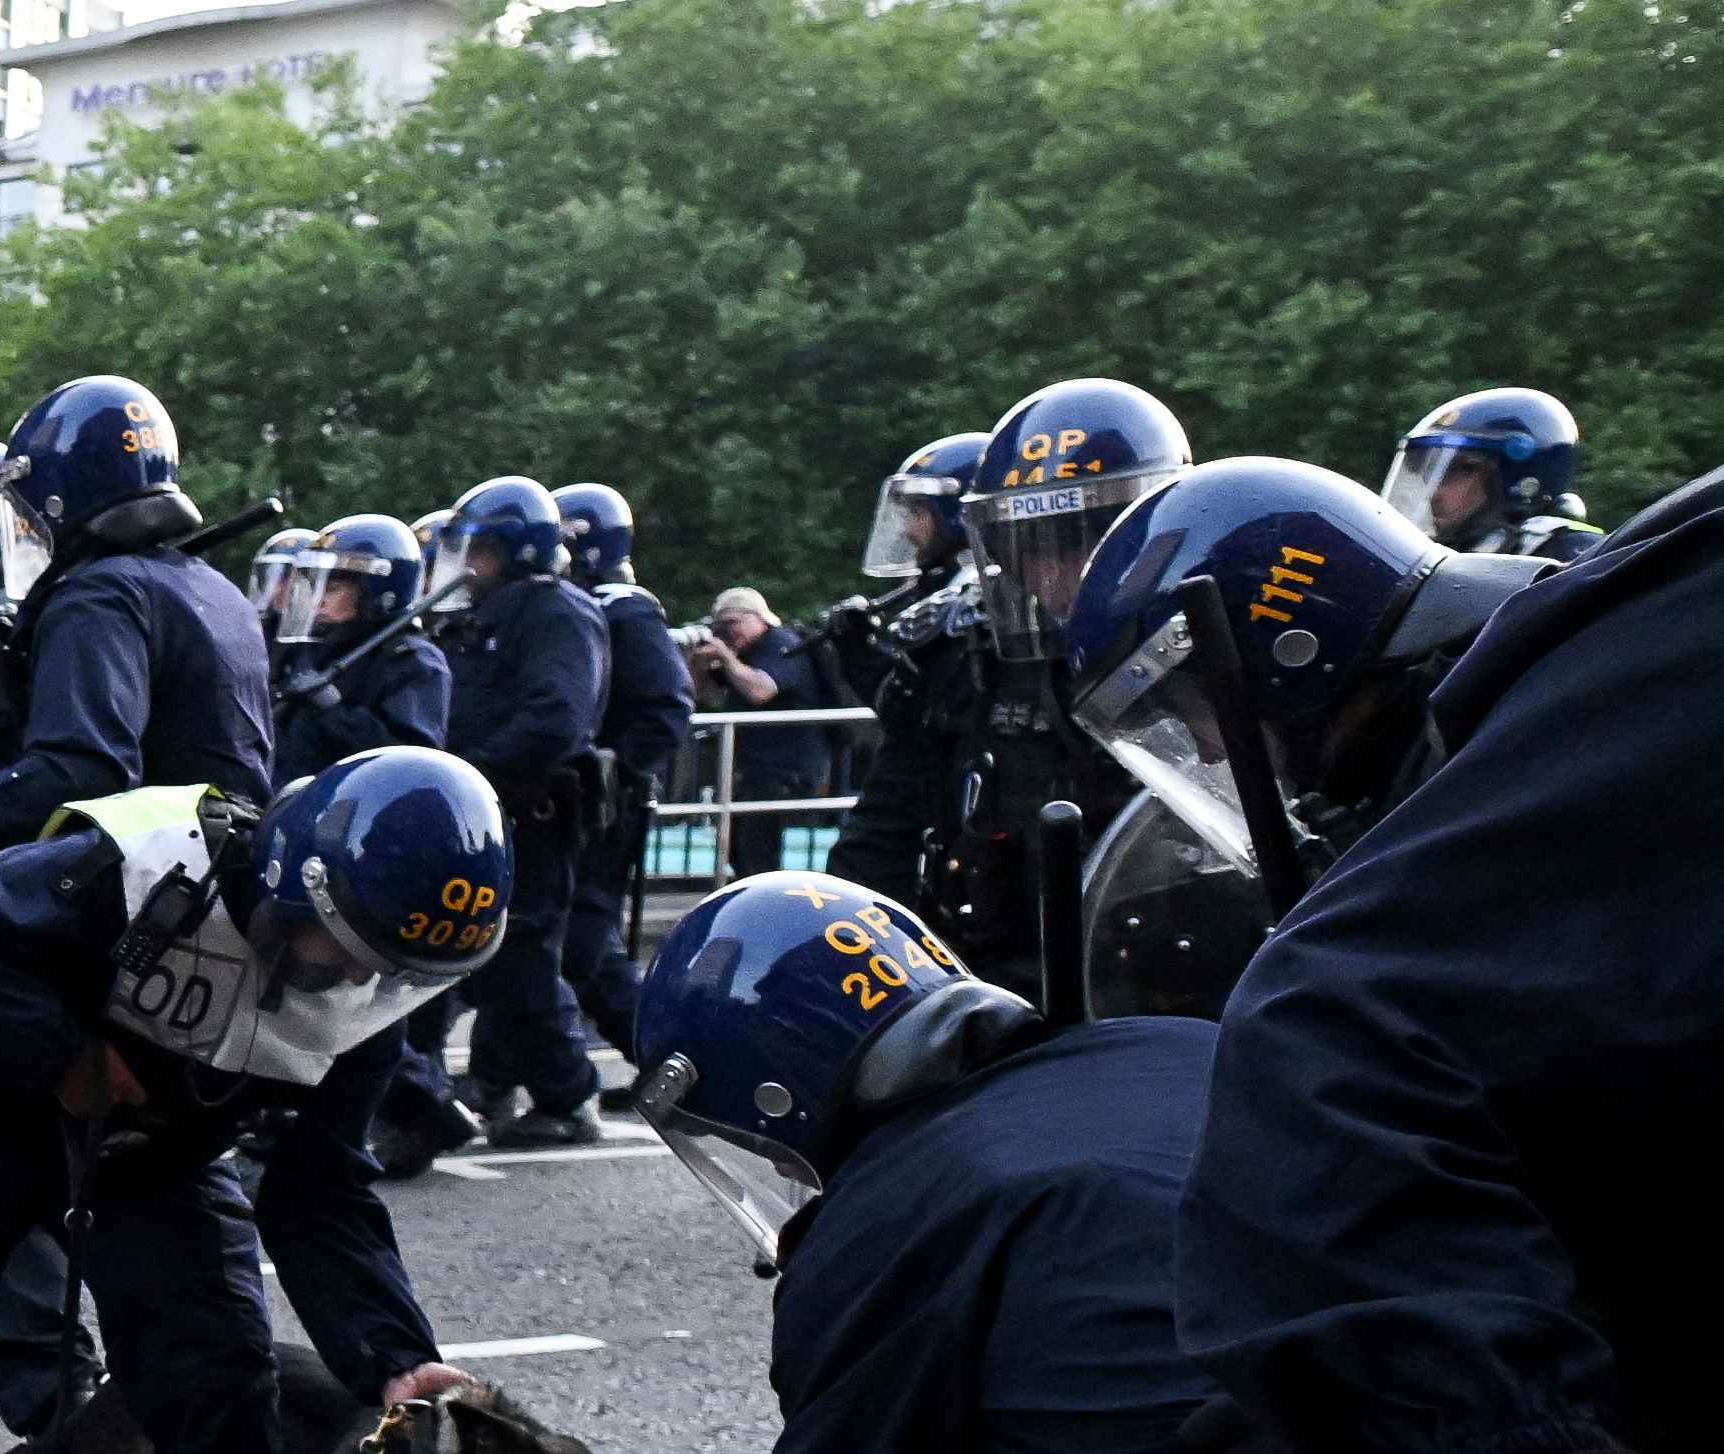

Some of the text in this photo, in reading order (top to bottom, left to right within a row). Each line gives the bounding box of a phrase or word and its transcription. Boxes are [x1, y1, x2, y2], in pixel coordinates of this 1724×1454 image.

[1021, 429, 1088, 461] QP
[1012, 490, 1080, 517] POLICE
[1249, 546, 1326, 622] 1111
[441, 878, 496, 917] QP
[824, 906, 892, 955] QP
[841, 936, 955, 1011] 2048
